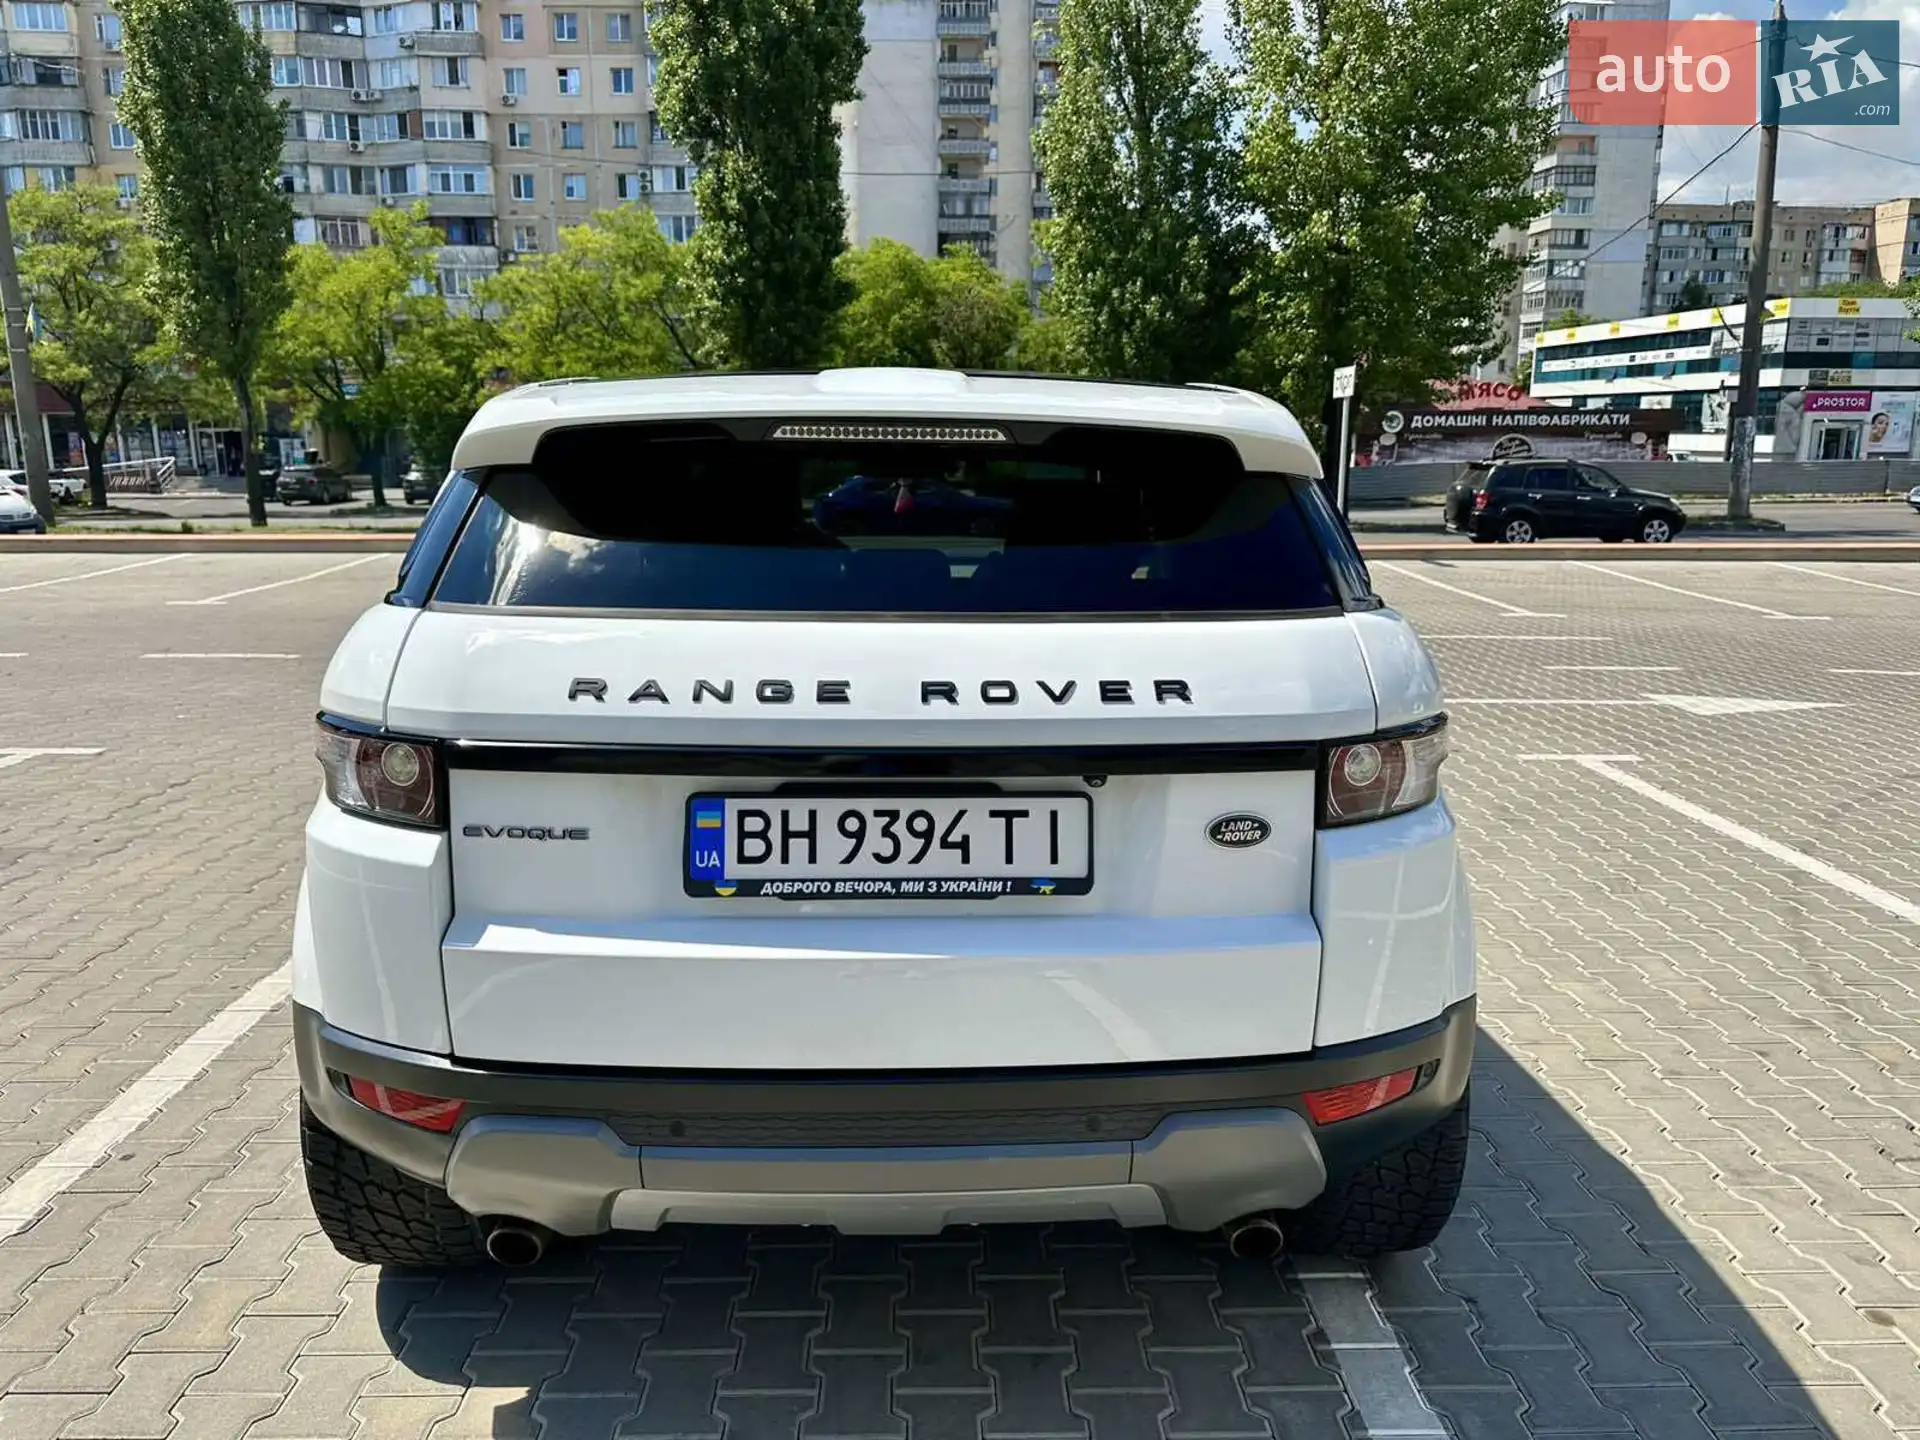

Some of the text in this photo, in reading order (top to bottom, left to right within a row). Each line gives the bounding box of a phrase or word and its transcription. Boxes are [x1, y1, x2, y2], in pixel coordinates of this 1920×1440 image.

[1817, 397, 1866, 407] PROSTOR
[1410, 413, 1631, 429] ДОМАШНІ НАПІВФАБРИКАТИ
[567, 677, 1195, 705] RANGE ROVER
[462, 824, 590, 841] EVOQUE
[836, 809, 971, 865] 9394
[695, 850, 721, 869] UA
[760, 881, 832, 896] ДОБРОГО
[834, 881, 897, 896] ВЕЧОРА,
[900, 881, 925, 893] МИ
[927, 881, 938, 893] З
[940, 878, 1003, 893] УКРАЇНИ
